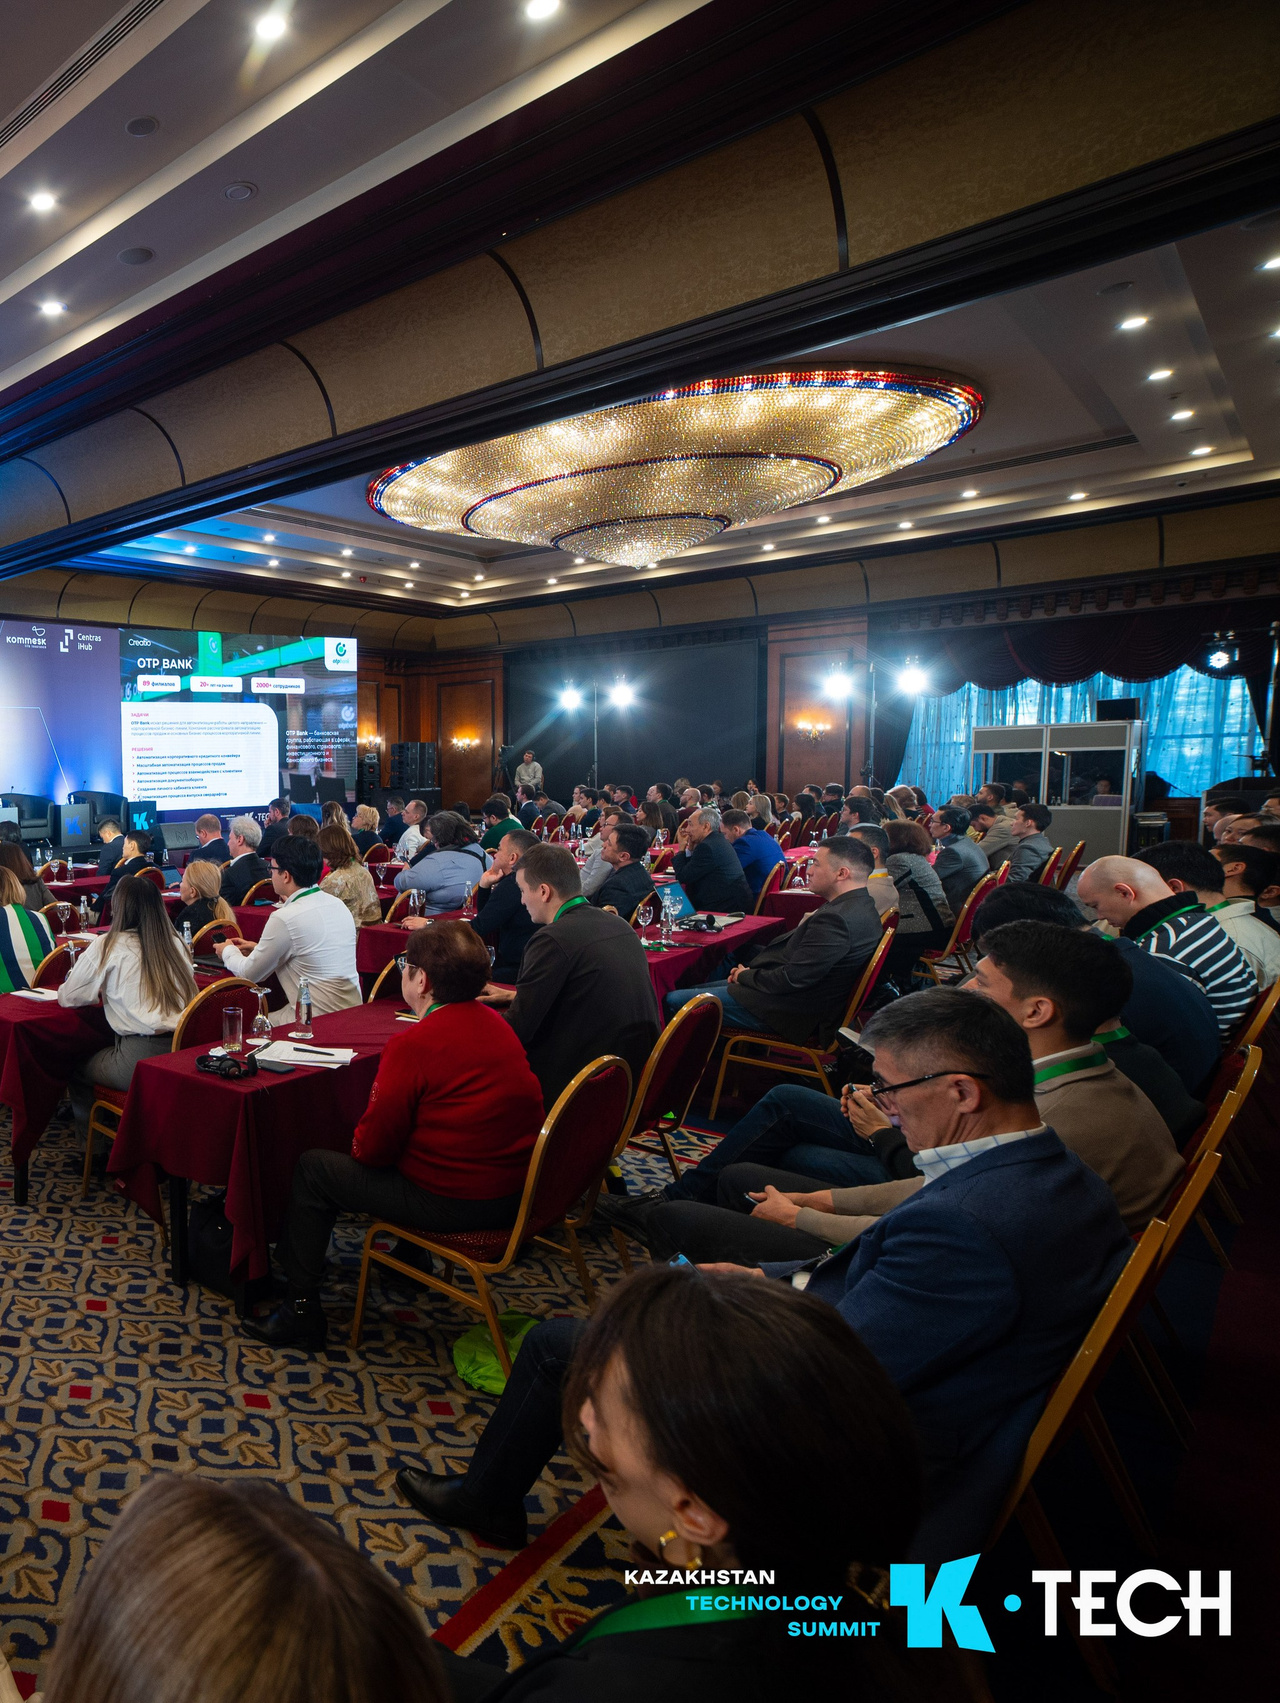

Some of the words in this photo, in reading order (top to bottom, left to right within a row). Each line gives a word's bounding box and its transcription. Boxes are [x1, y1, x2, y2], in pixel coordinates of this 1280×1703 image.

[77, 633, 102, 642] Centras
[77, 643, 93, 651] iHub
[137, 658, 159, 668] OTP
[162, 658, 193, 669] BANK
